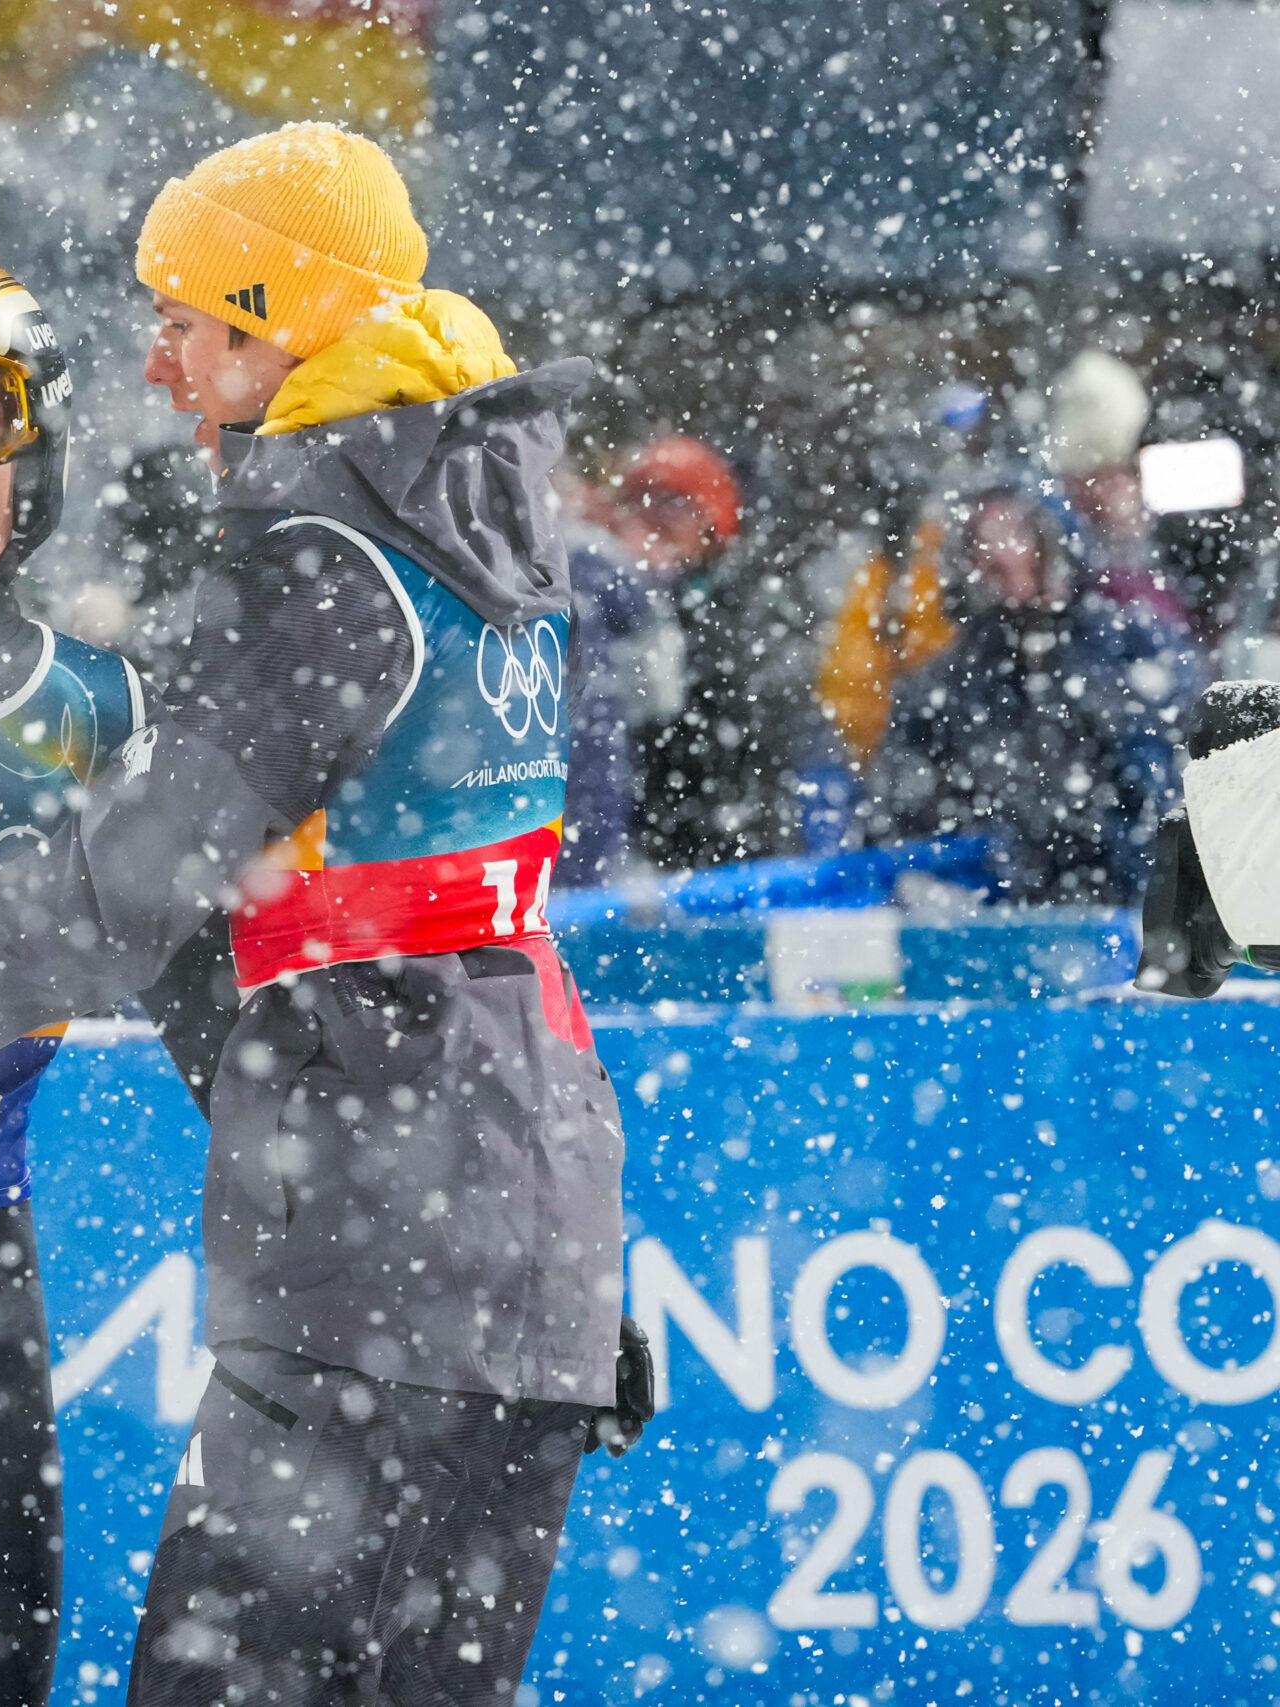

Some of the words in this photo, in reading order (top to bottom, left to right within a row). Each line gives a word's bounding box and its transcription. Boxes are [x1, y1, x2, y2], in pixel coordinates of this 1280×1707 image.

[25, 323, 58, 350] uve
[450, 762, 528, 789] MILANO
[767, 1446, 1202, 1630] 2026
